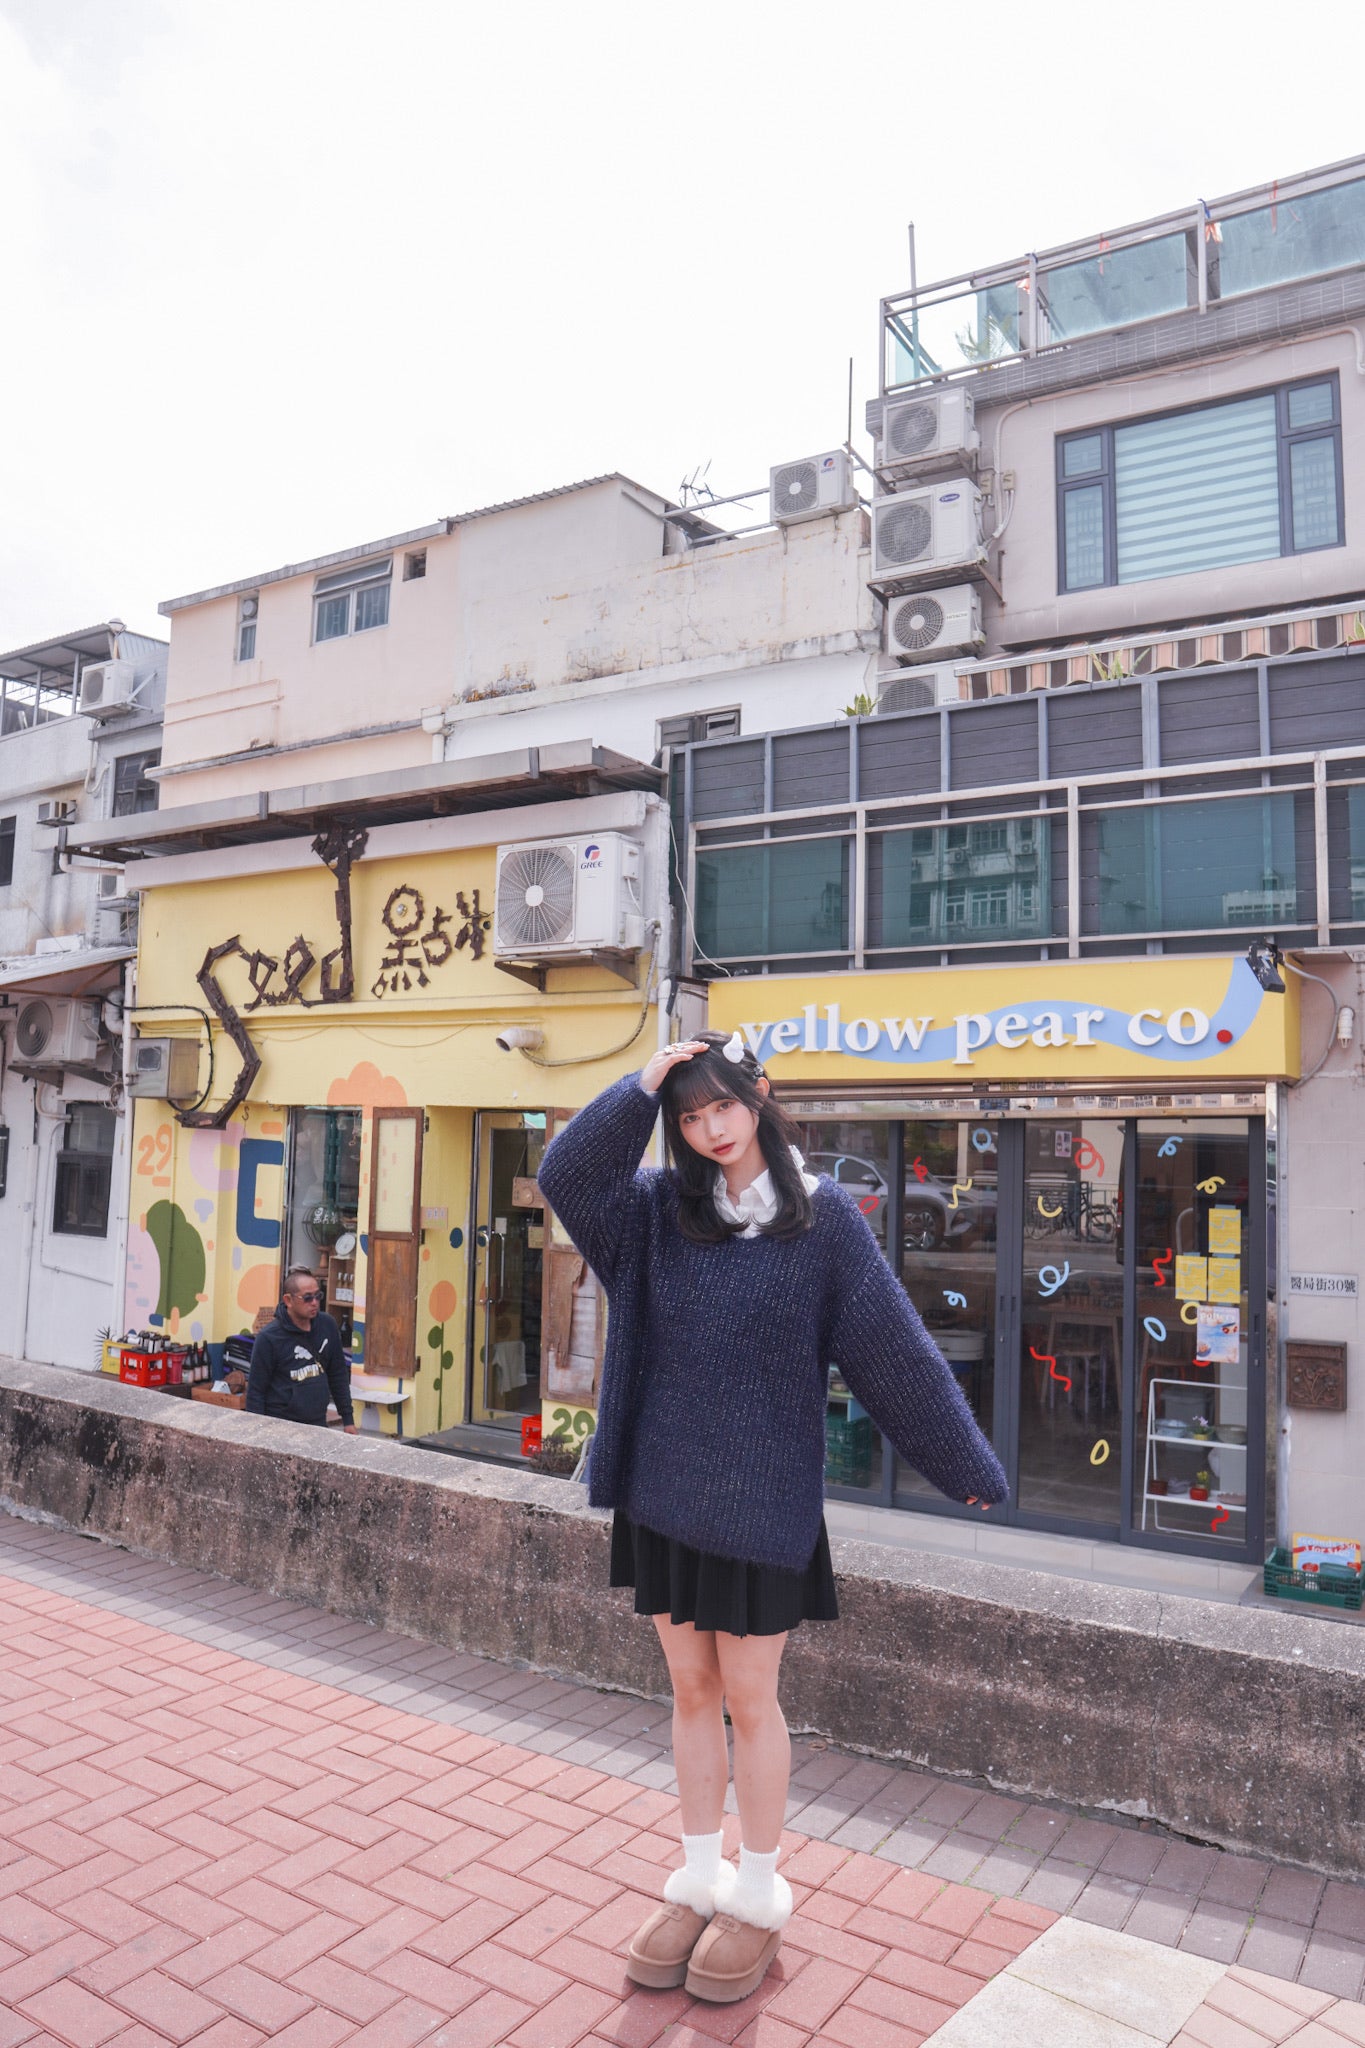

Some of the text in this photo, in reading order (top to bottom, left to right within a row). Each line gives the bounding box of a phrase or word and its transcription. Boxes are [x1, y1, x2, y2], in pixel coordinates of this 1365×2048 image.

[580, 861, 604, 869] GREE
[739, 1003, 1233, 1065] yellow pear co.
[137, 1122, 173, 1176] 29
[552, 1408, 597, 1455] 29
